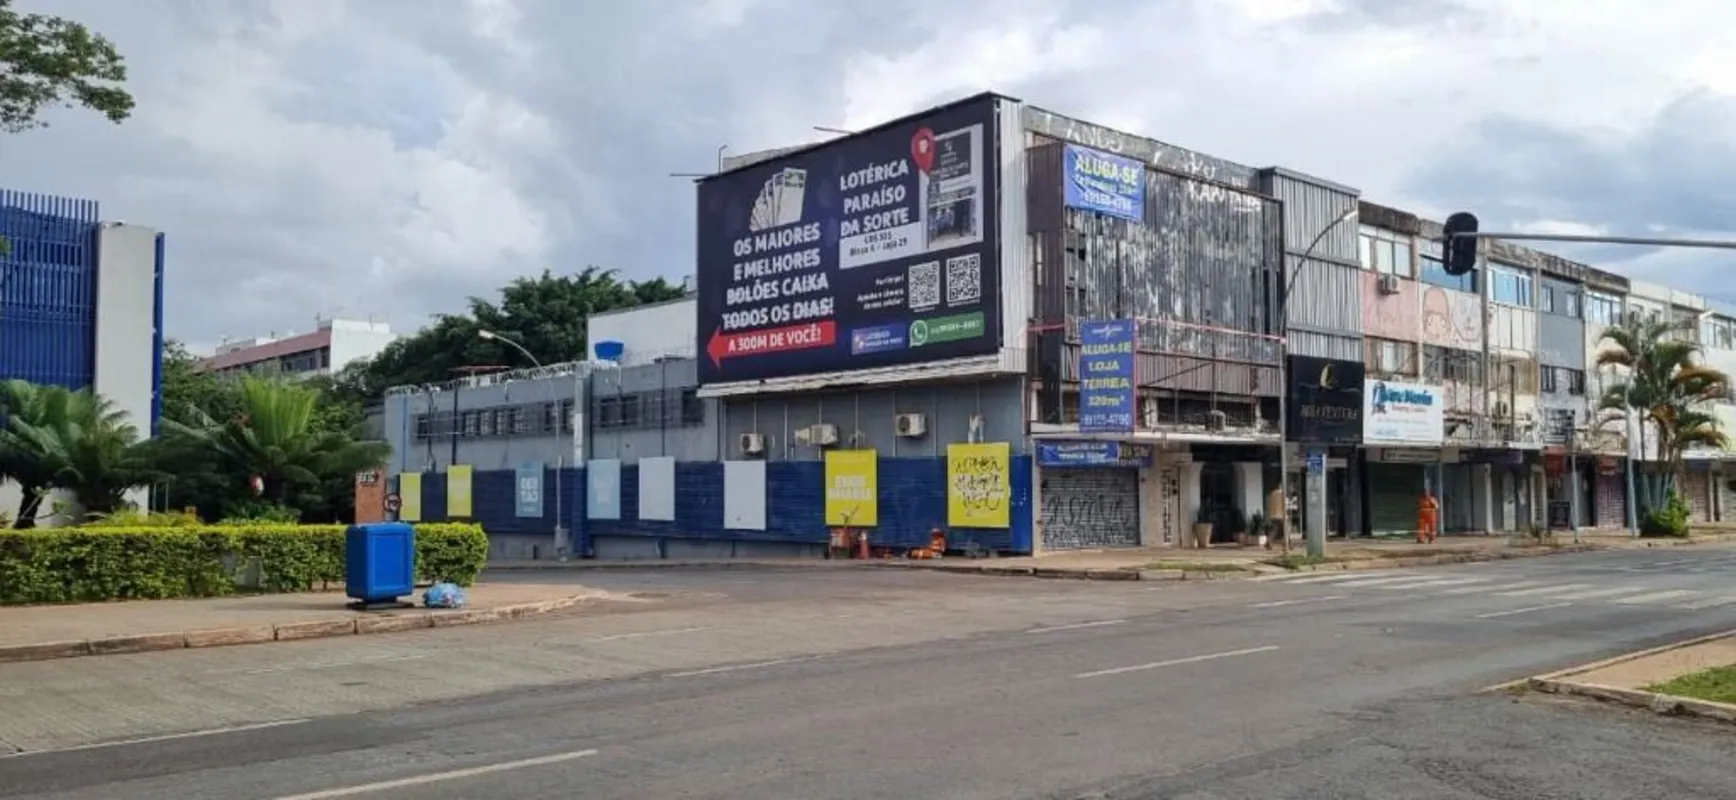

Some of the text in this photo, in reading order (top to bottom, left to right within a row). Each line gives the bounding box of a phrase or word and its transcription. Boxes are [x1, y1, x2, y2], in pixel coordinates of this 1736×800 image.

[840, 159, 909, 191] LOTÉRICA
[1075, 154, 1137, 186] ALUGA-SE
[843, 184, 906, 214] PARAÍSO
[840, 207, 909, 237] DA SORTE
[733, 222, 820, 257] OS MAIORES
[733, 248, 820, 281] E MELHORES
[726, 272, 828, 306] BOLÕES CAIXA
[721, 296, 834, 330] TODOS OS DIAS!
[728, 339, 737, 353] A
[770, 333, 784, 347] DE
[786, 323, 821, 344] VOCÊ!
[1081, 341, 1132, 356] ALUGA-SE
[1088, 360, 1120, 372] LOJA
